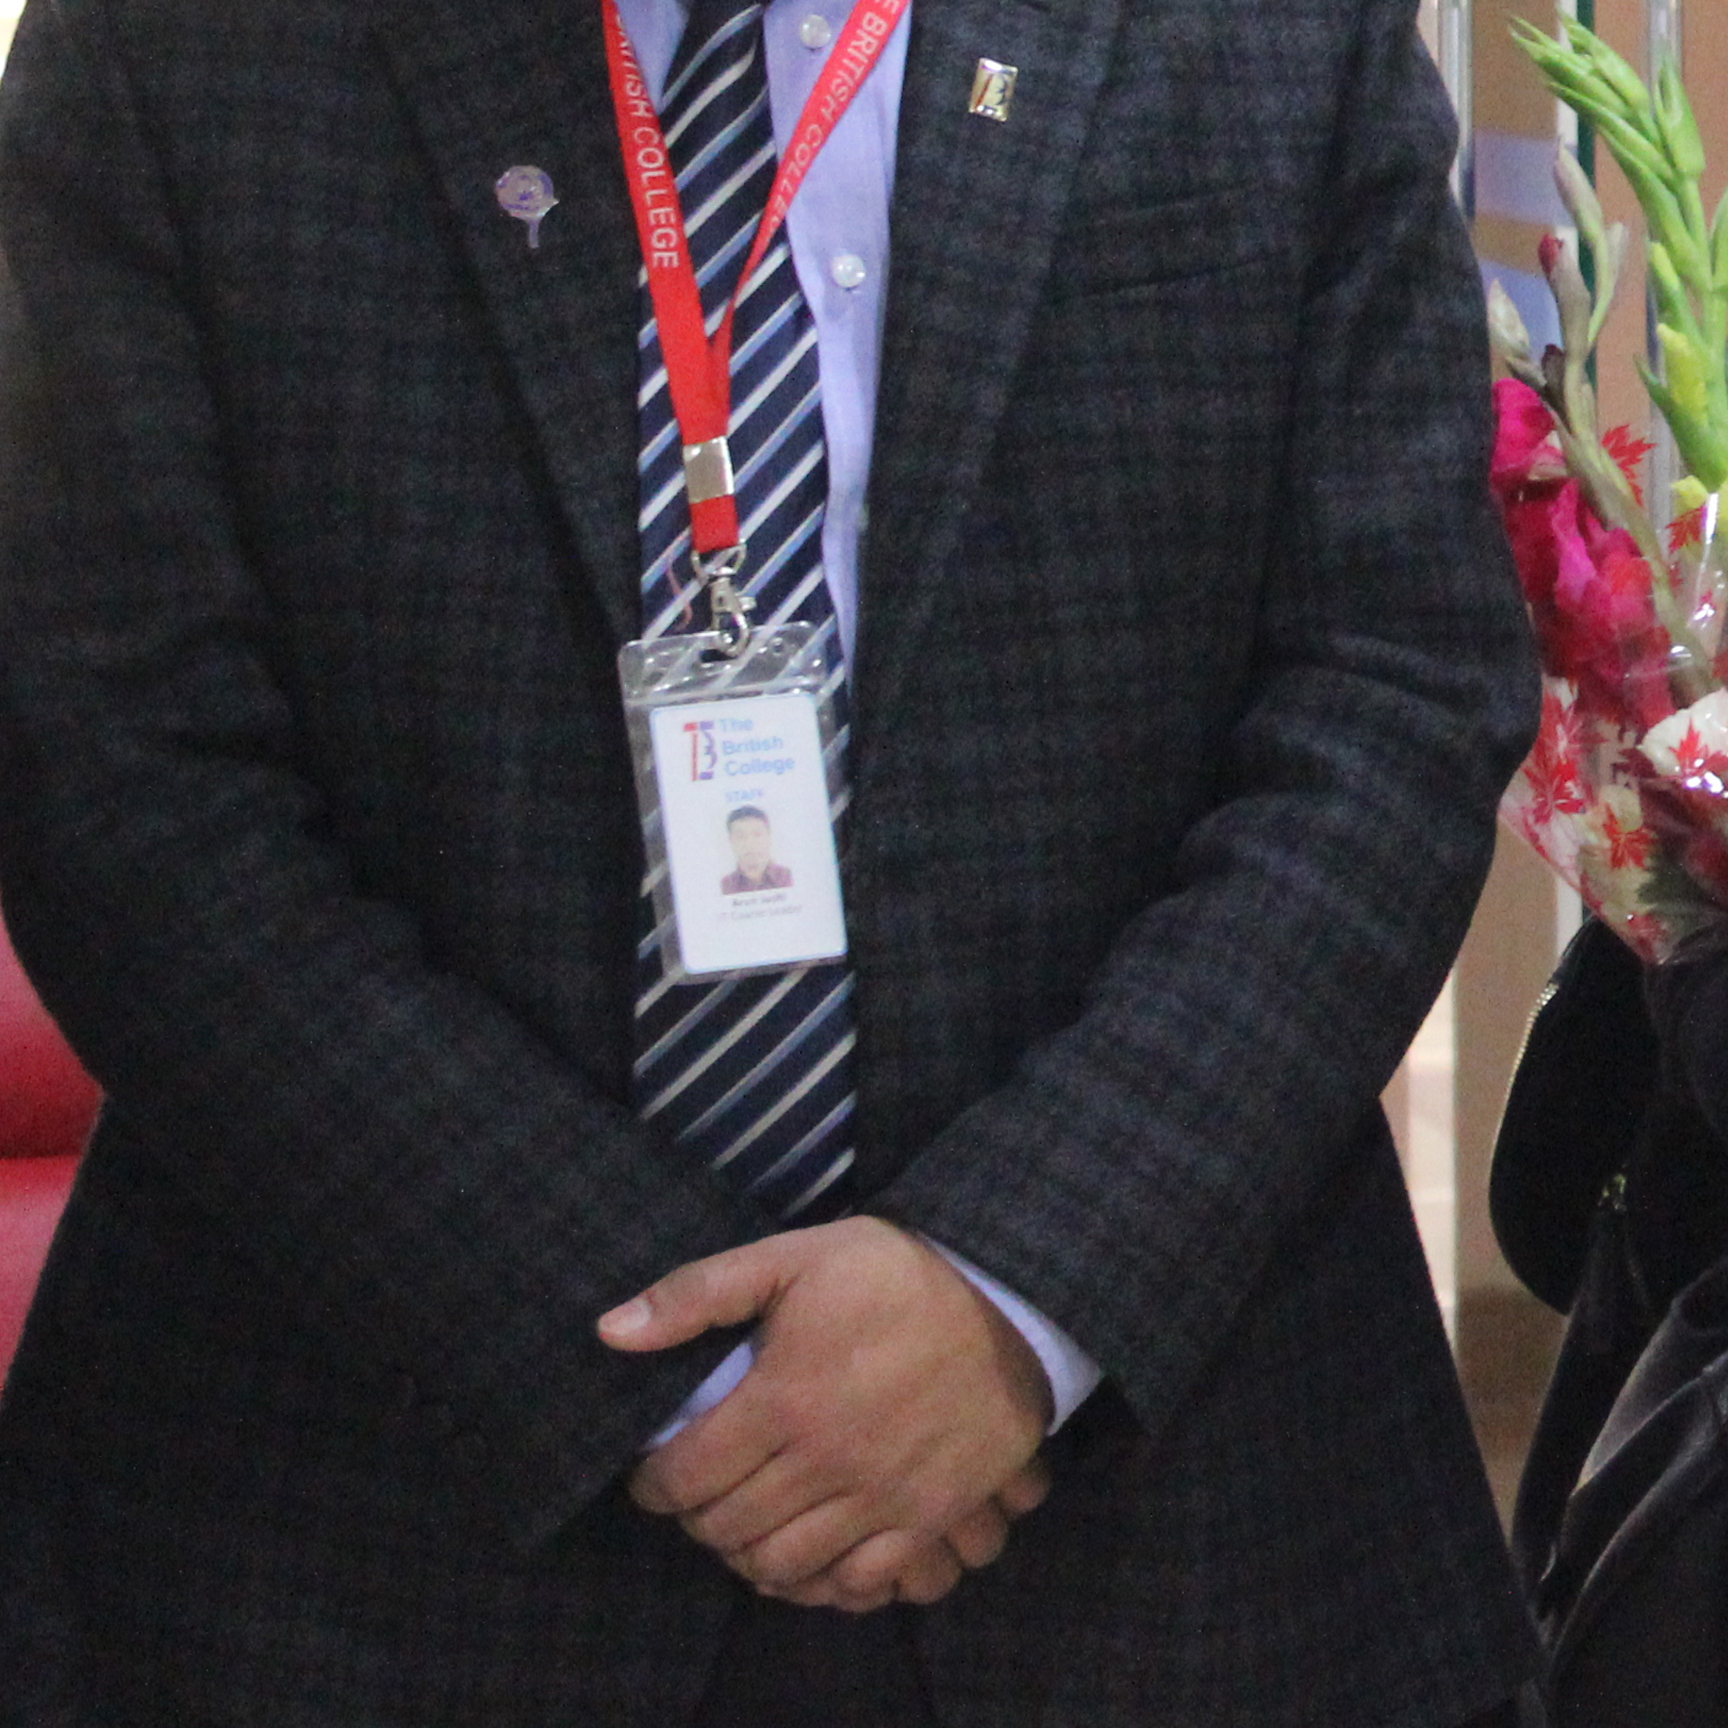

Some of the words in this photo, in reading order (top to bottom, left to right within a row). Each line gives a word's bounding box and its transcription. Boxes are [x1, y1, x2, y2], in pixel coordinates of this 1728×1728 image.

[820, 13, 888, 122] BRITISH
[634, 128, 680, 269] COLLEGE
[769, 122, 824, 233] COLLE
[722, 735, 784, 756] British
[724, 756, 796, 777] College
